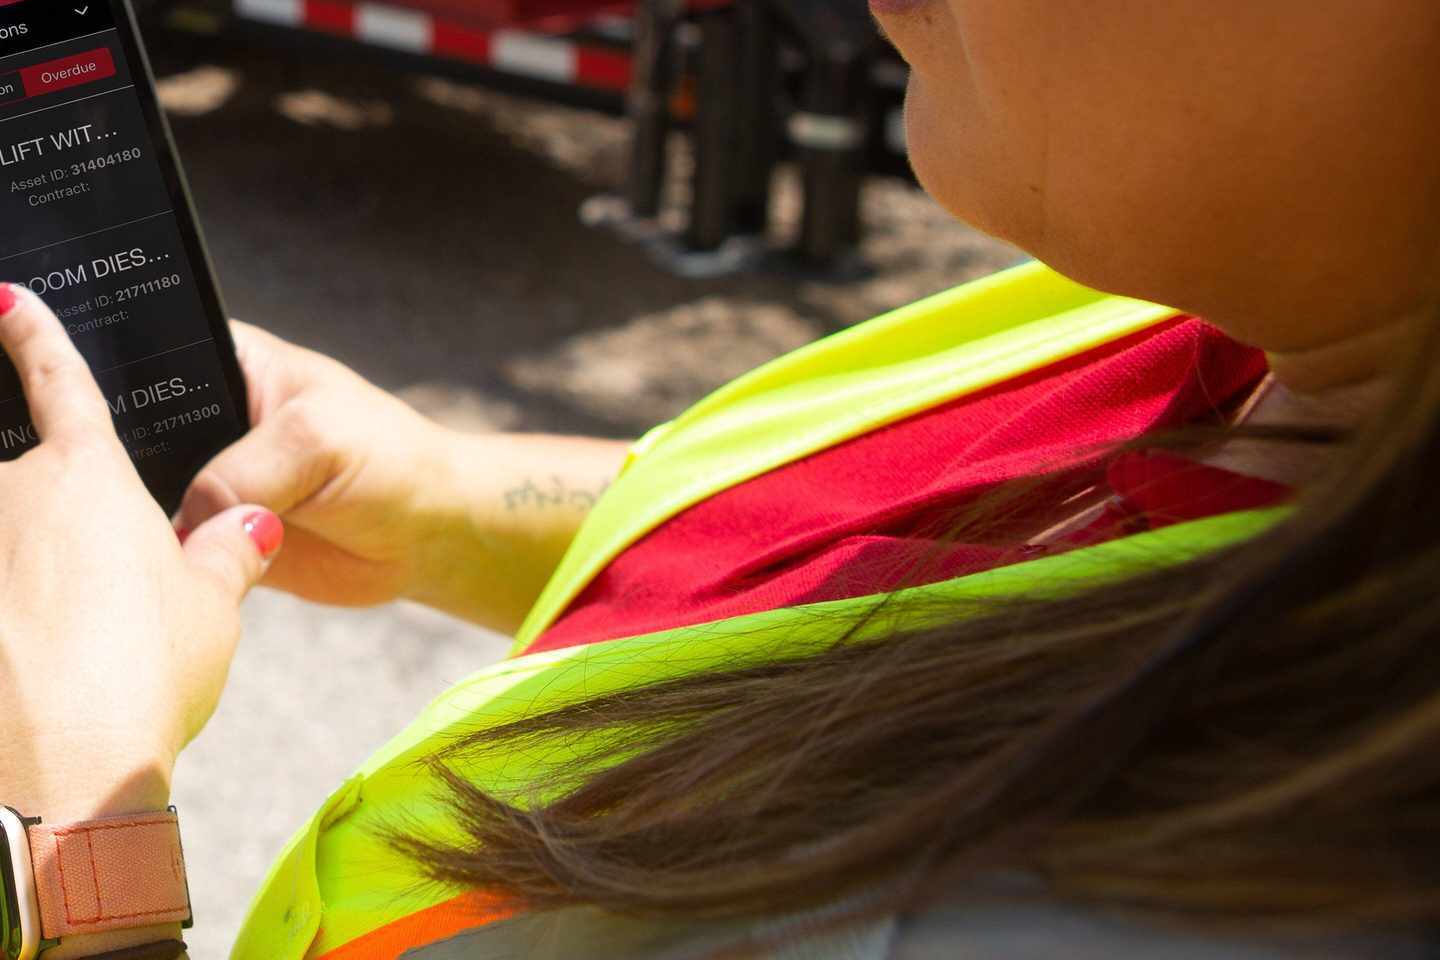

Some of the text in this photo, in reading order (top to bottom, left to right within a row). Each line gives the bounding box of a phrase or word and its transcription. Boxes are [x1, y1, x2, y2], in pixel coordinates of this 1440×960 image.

[41, 60, 97, 84] Overdue
[10, 147, 142, 193] Asset ID: 31404180
[28, 183, 90, 207] Contract:
[16, 263, 88, 297] OOM
[95, 293, 114, 309] ID:
[115, 273, 181, 303] 21711180
[153, 403, 221, 434] 21711300
